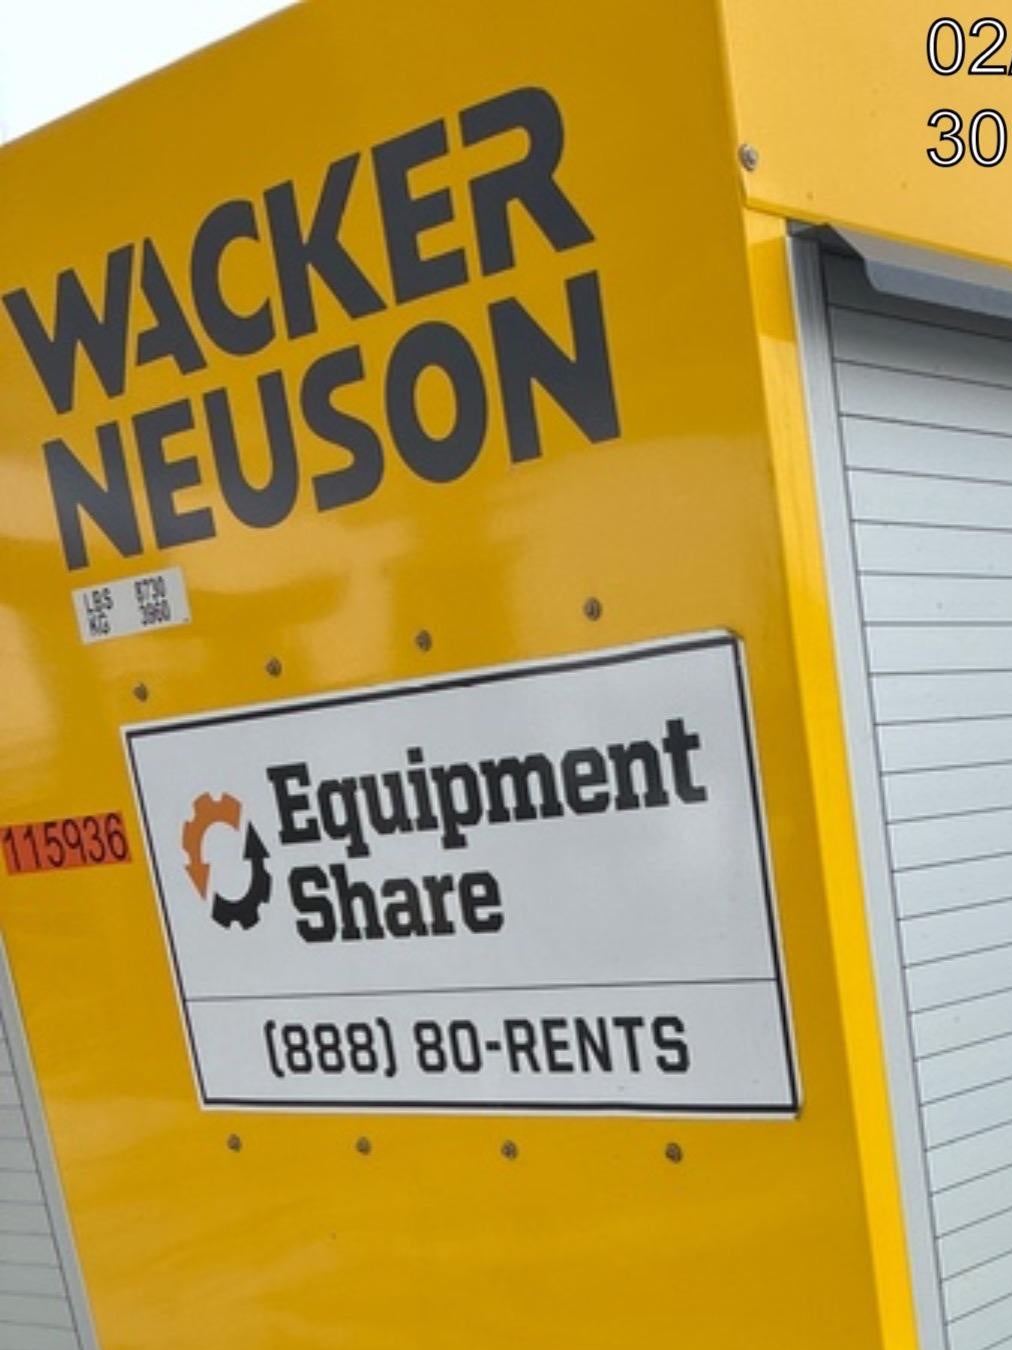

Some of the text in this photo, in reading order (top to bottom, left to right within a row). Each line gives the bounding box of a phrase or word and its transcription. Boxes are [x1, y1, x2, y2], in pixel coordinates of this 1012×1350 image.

[3, 86, 595, 414] WACKER
[43, 270, 621, 571] NEUSON
[3, 811, 130, 872] 115936
[267, 718, 709, 860] Equipment
[288, 865, 506, 944] Share
[263, 1015, 691, 1078] (888) 80-RENTS
